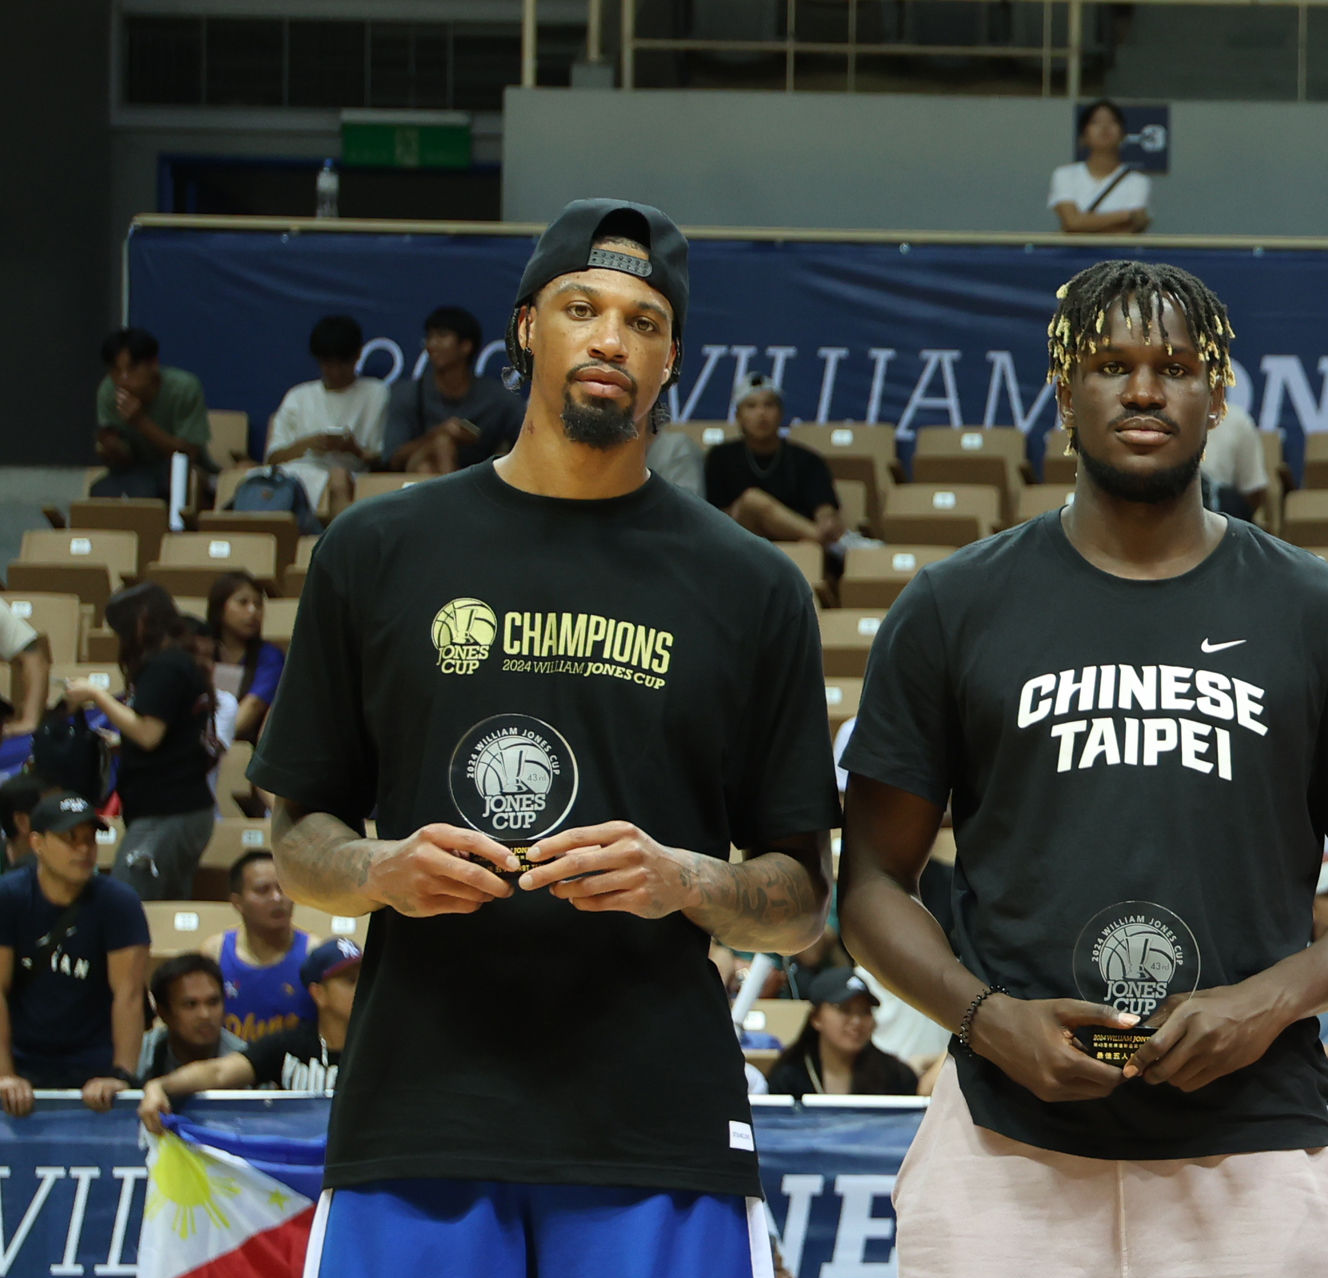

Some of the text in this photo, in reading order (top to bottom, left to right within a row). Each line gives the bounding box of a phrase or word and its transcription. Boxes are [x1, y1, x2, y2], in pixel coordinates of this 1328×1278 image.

[436, 644, 490, 666] JONES
[502, 611, 674, 675] CHAMPIONS
[440, 659, 480, 675] CUP
[502, 658, 665, 690] 2024 WILLIAM JONES CUP
[1017, 664, 1269, 736] CHINESE
[466, 727, 561, 779] 2024 WILLIAM JONES CUP
[1051, 717, 1233, 781] TAIPEI
[482, 794, 546, 818] JONES
[492, 811, 537, 830] CUP
[1091, 915, 1184, 966] 2024 WILLIAM JONES CUP
[1104, 980, 1168, 1001] JONES
[1112, 998, 1157, 1016] CUP
